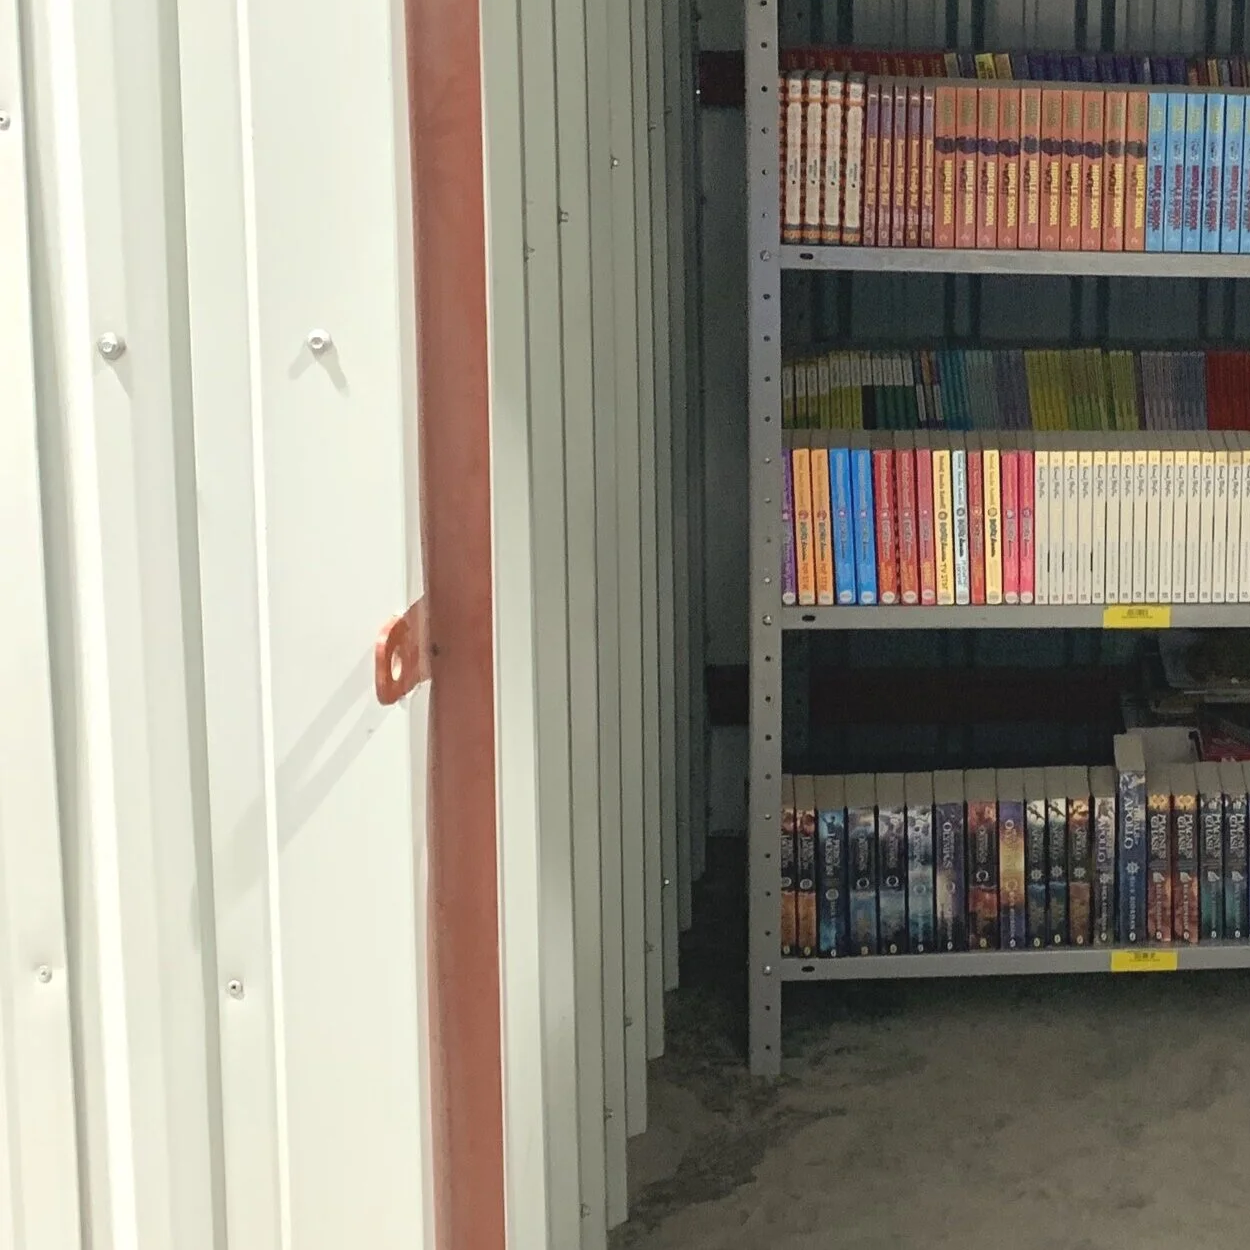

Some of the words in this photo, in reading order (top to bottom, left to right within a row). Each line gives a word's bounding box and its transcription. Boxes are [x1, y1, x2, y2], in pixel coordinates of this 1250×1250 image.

[943, 194, 953, 225] SCHOOL
[965, 194, 975, 225] SCHOOL
[985, 195, 996, 226] SCHOOL
[1007, 196, 1017, 227] SCHOOL
[1027, 194, 1037, 225] SCHOOL
[1049, 196, 1059, 227] SCHOOL
[1069, 196, 1079, 227] SCHOOL
[1090, 198, 1101, 229] SCHOOL
[1113, 197, 1123, 228] SCHOOL
[1134, 197, 1145, 228] SCHOOL
[1124, 796, 1135, 849] APOLLO
[1176, 815, 1185, 853] CHASE
[1184, 813, 1193, 858] MAGNUS
